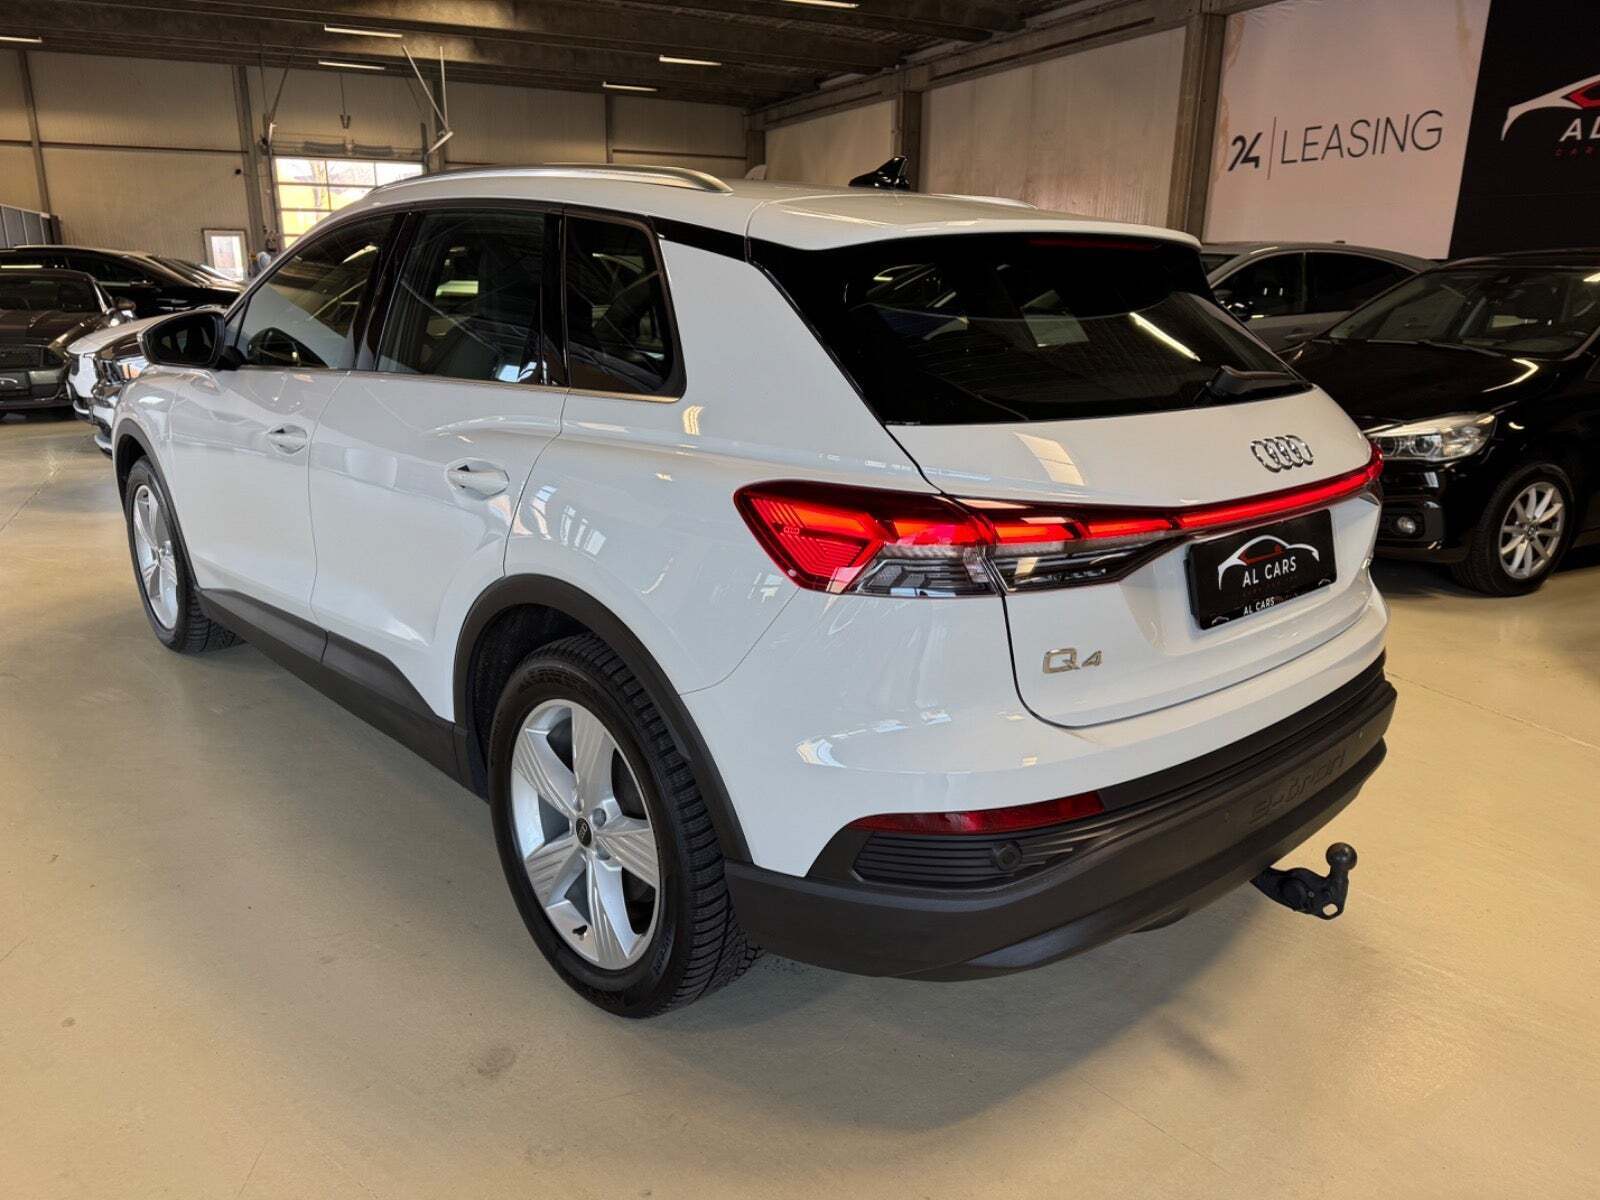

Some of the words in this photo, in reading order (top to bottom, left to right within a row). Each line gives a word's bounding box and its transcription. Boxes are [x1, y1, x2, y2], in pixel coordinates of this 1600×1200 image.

[1280, 109, 1443, 165] LEASING
[1242, 568, 1260, 588] AL
[1264, 556, 1297, 580] CARS
[1243, 603, 1254, 616] AL
[1255, 596, 1275, 611] CARS
[1042, 647, 1102, 674] Q4
